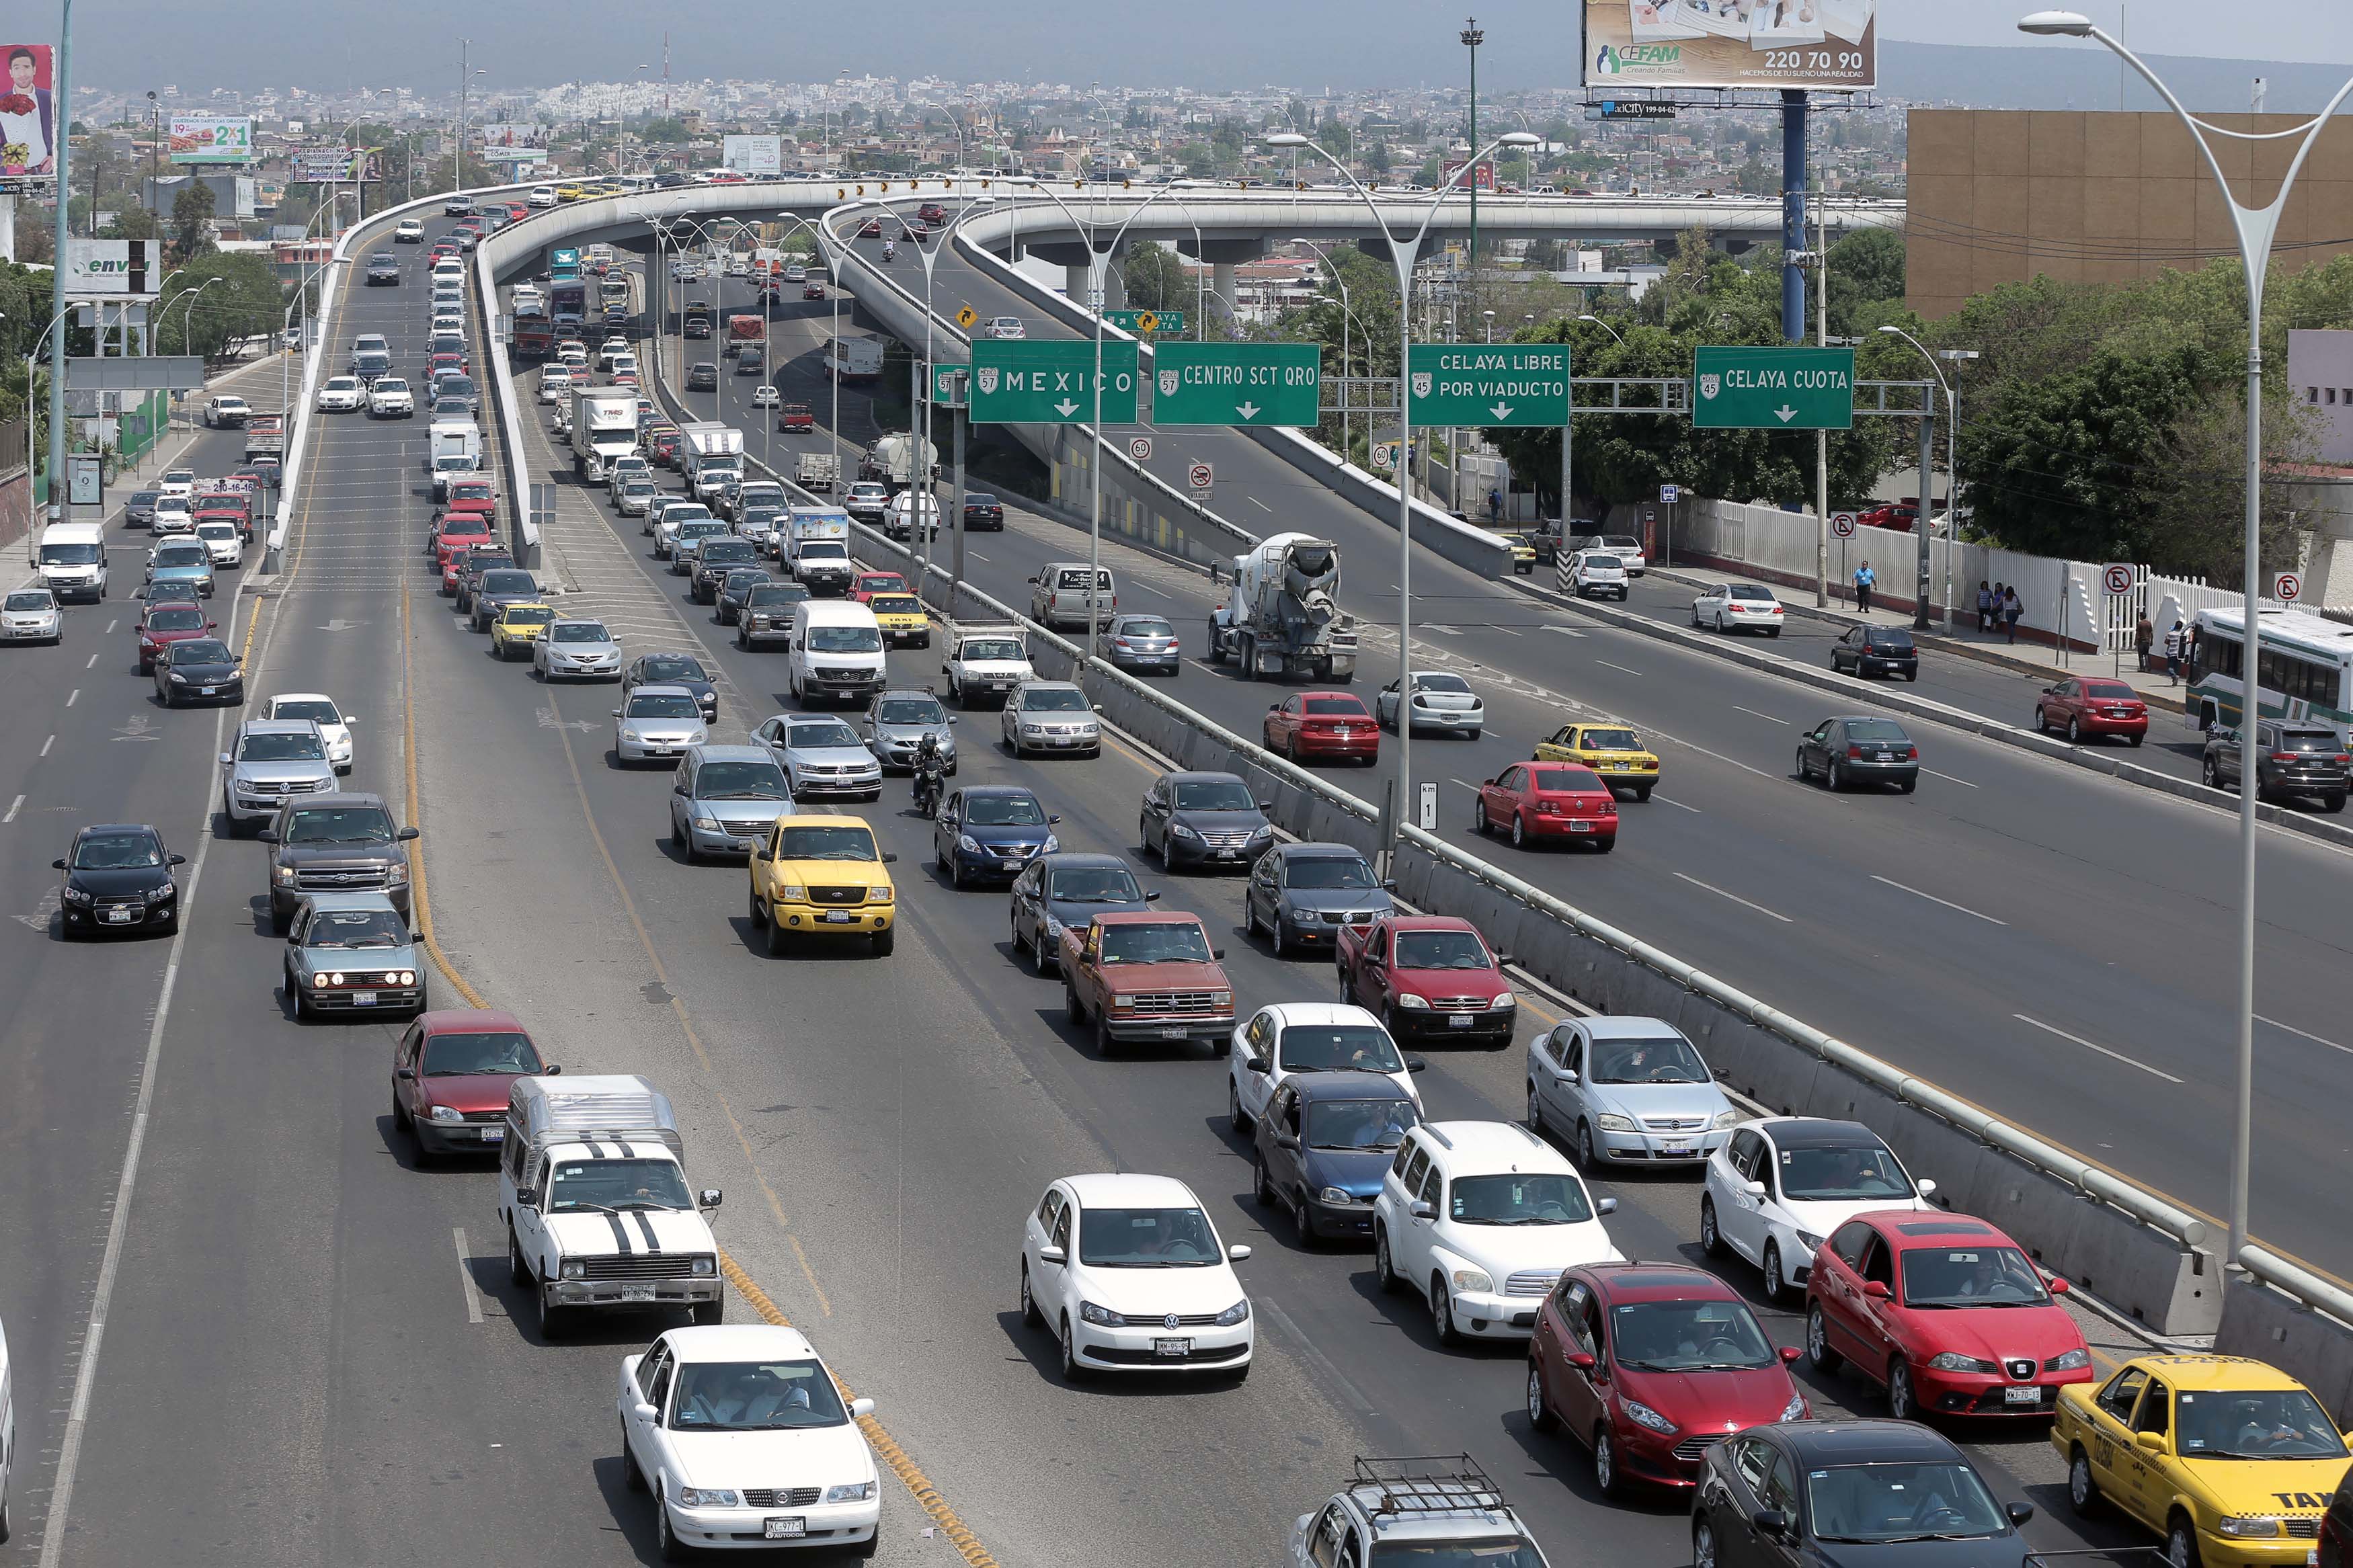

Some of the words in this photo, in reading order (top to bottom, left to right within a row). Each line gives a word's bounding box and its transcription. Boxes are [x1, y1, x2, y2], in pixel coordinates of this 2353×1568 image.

[1620, 45, 1679, 62] CEFAM
[1765, 51, 1800, 68] 220
[1808, 52, 1830, 69] 70
[1839, 52, 1862, 69] 90
[1792, 69, 1816, 77] SUEÑO
[1615, 103, 1645, 117] adCity
[175, 124, 186, 134] 19
[1440, 354, 1507, 370] CELAYA
[1513, 355, 1563, 370] LIBRE
[1184, 365, 1243, 385] CENTRO
[1249, 366, 1278, 386] SCT
[1285, 366, 1315, 386] QRO
[1726, 370, 1788, 388] CELAYA
[1794, 370, 1848, 389] CUOTA
[941, 380, 950, 388] 57
[982, 377, 995, 388] 57
[1006, 372, 1131, 392] MEXICO
[1163, 380, 1175, 391] 57
[1416, 382, 1429, 393] 45
[1440, 381, 1474, 397] POR
[1478, 381, 1564, 397] VIADUCTO
[1704, 384, 1716, 394] 45
[1135, 443, 1146, 452] 60
[1378, 450, 1386, 458] 60
[213, 483, 253, 492] 210-16-16
[1190, 491, 1211, 499] VIADUCTO
[1423, 785, 1435, 793] km
[1426, 803, 1430, 817] 1
